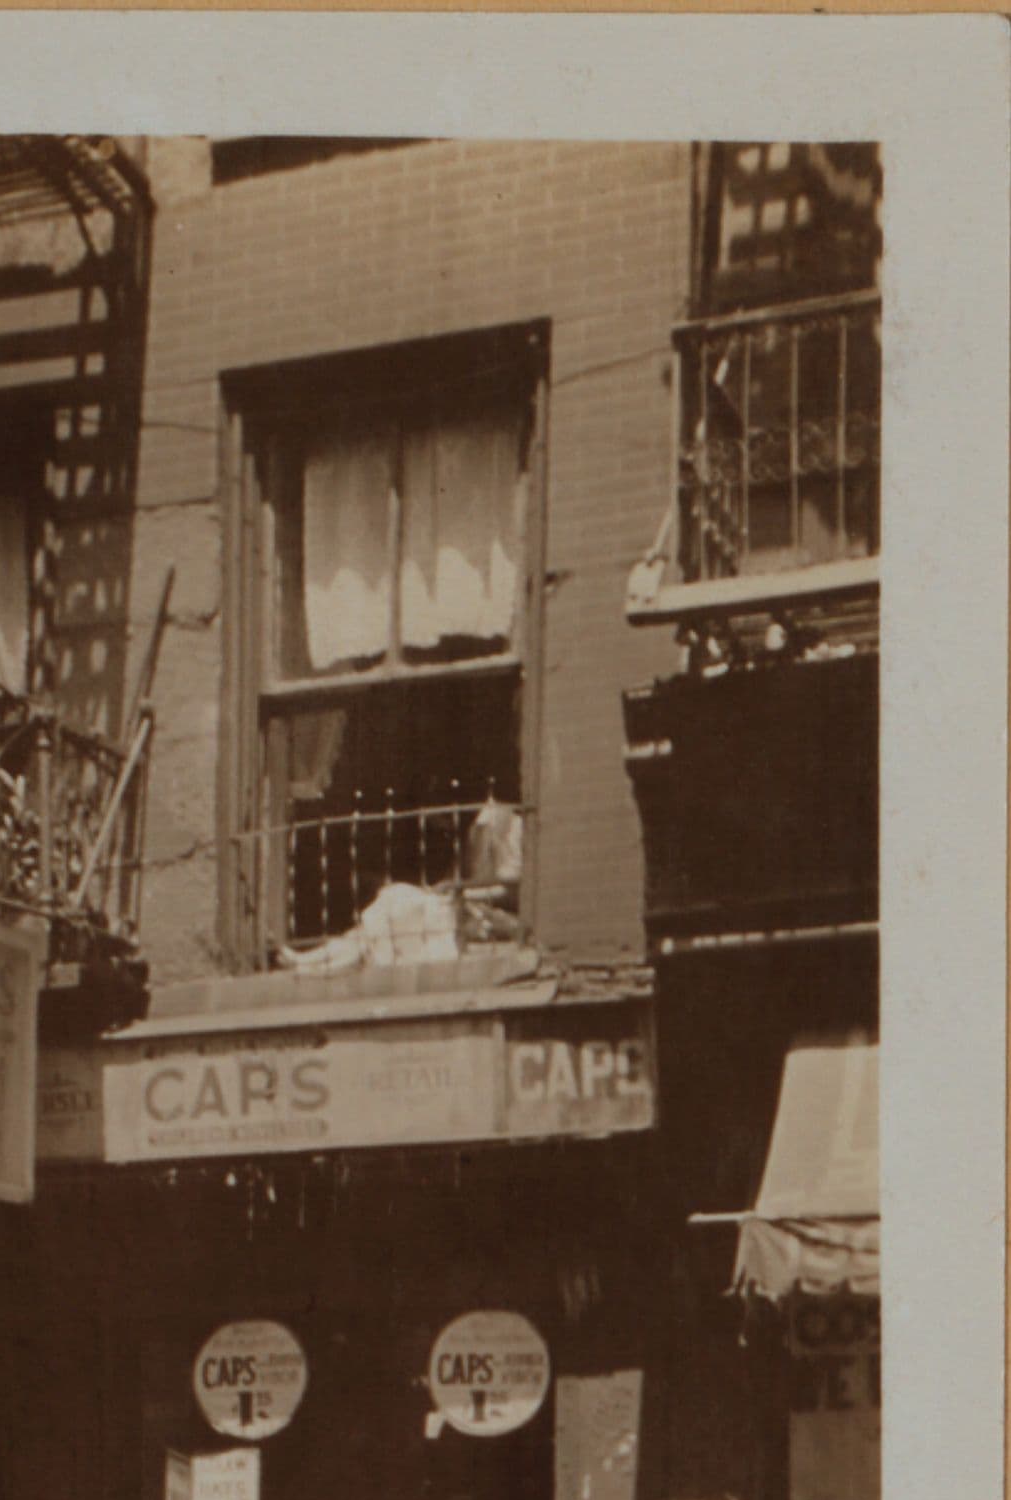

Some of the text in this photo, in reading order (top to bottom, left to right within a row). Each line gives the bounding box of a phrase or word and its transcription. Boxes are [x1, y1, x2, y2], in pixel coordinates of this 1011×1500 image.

[145, 1059, 330, 1122] CAPS
[512, 1039, 654, 1101] CAPS
[202, 1355, 256, 1389] CAPS
[437, 1352, 493, 1385] CAPS
